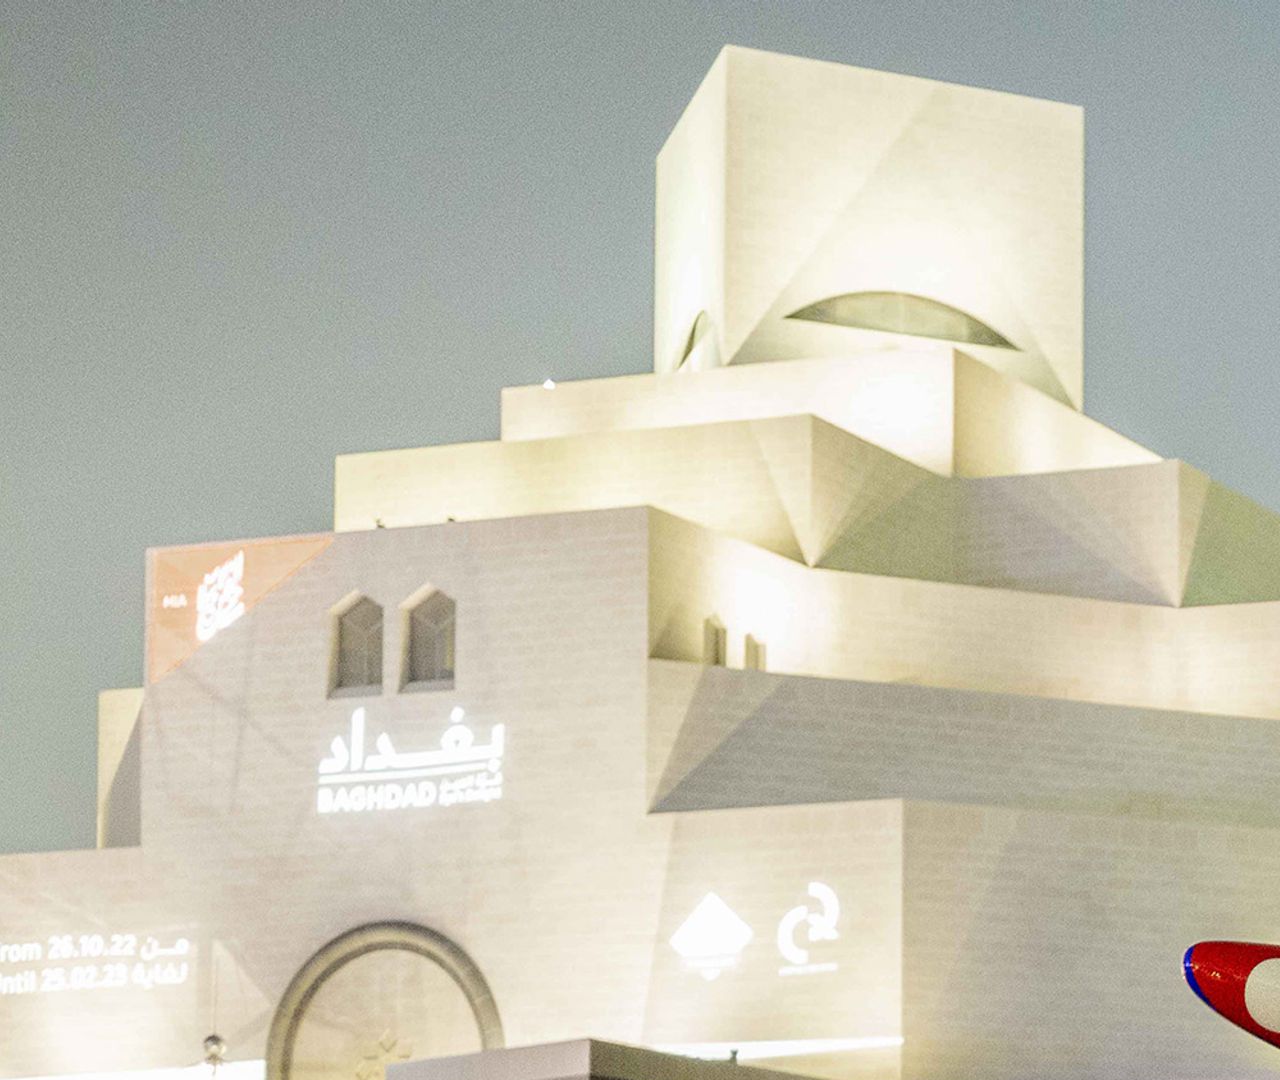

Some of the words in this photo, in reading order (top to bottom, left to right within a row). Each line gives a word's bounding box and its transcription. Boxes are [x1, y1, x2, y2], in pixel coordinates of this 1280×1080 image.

[318, 706, 505, 774] بغداد
[317, 781, 437, 813] BAGHDAD
[0, 943, 42, 962] rom
[48, 934, 137, 960] 26.10.22
